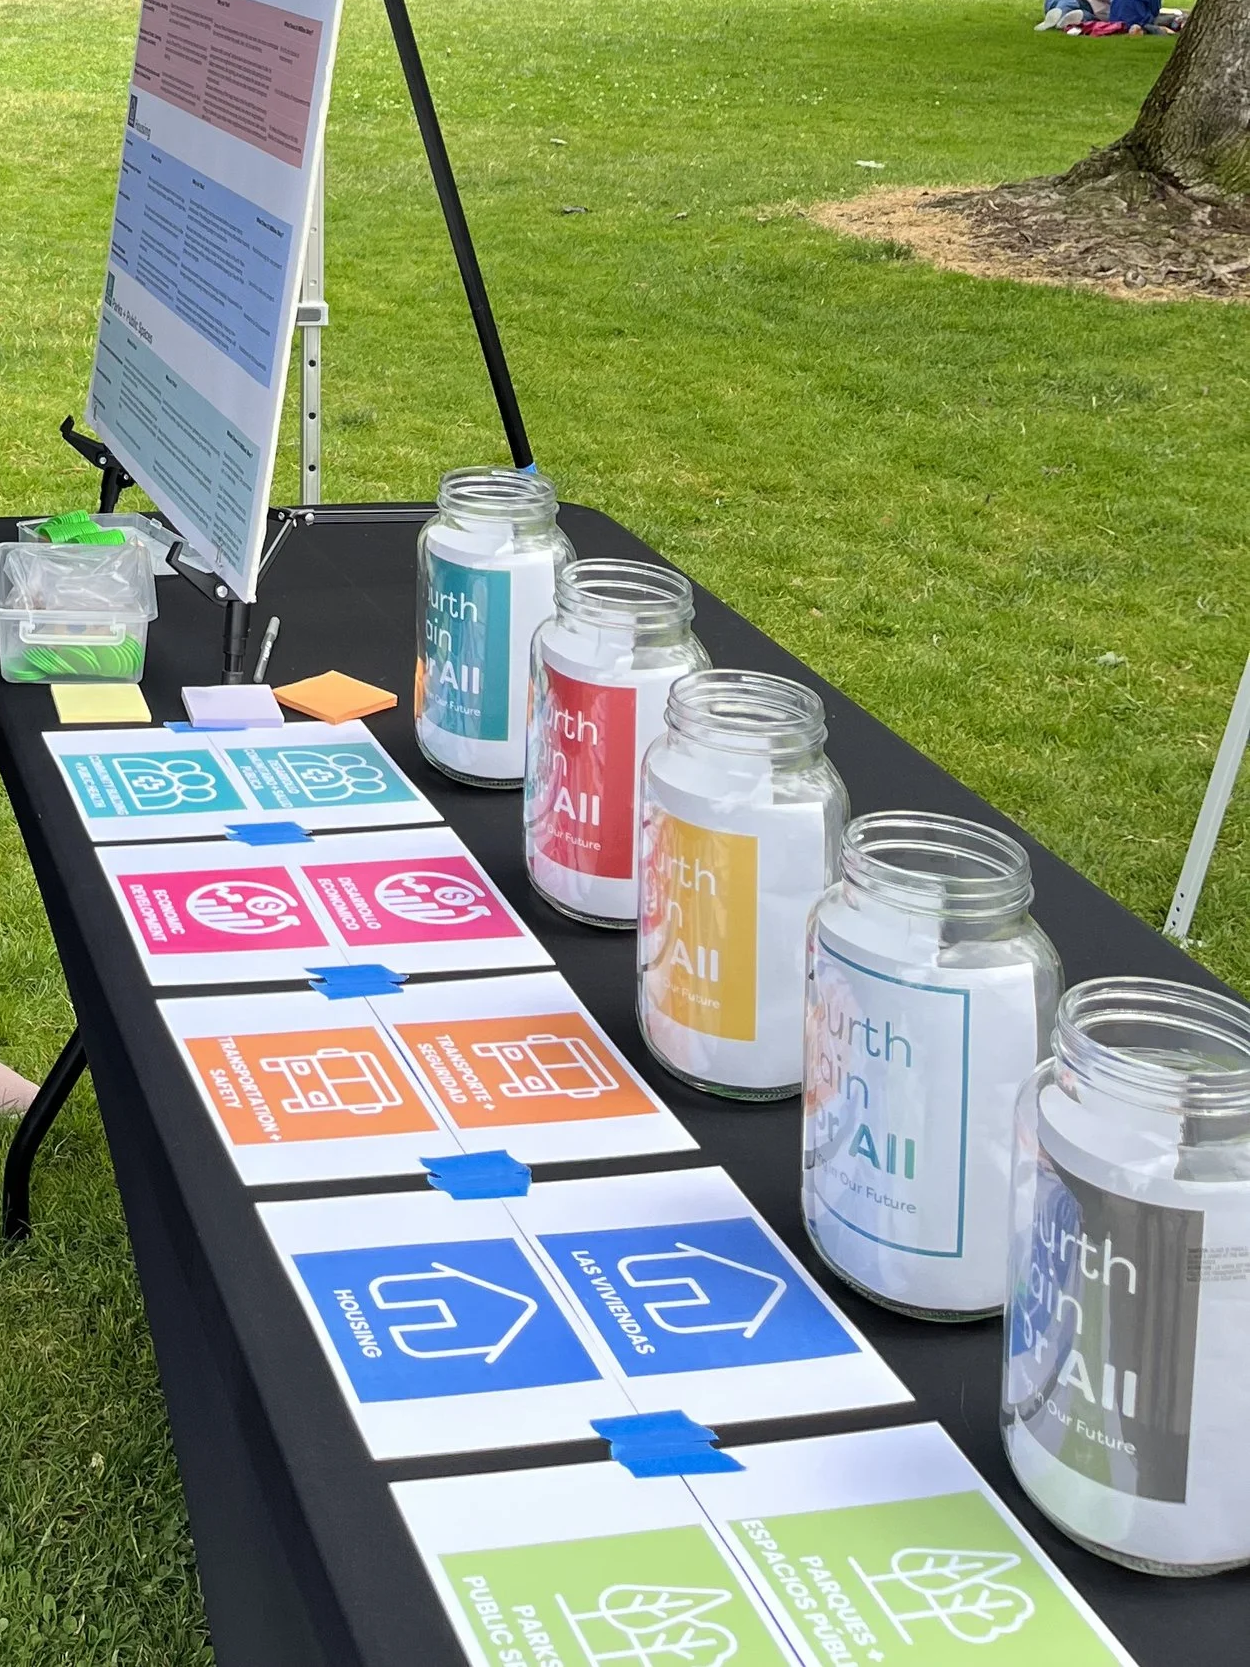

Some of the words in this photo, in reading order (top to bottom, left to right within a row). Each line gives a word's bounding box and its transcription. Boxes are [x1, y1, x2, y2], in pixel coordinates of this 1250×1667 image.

[439, 660, 480, 695] All
[449, 700, 481, 717] Future
[553, 785, 600, 826] All
[565, 831, 602, 851] Future
[128, 884, 168, 943] DEVELOPMENT
[152, 889, 186, 935] ECONOMIC
[337, 876, 382, 930] DESARROLLO
[669, 937, 719, 982] All
[681, 987, 721, 1009] Future
[209, 1068, 244, 1109] SAFETY
[217, 1036, 281, 1133] TRANSPORTATION
[416, 1042, 468, 1104] SEGURIDAD
[435, 1034, 493, 1103] TRANSPORTE
[848, 1123, 915, 1180] All
[839, 1171, 863, 1194] Our
[866, 1187, 917, 1214] Future
[1037, 1221, 1137, 1295] urth
[333, 1289, 383, 1359] HOUSING
[570, 1250, 603, 1276] LAS
[590, 1276, 656, 1355] VIVIENDAS
[1057, 1349, 1137, 1418] All
[1047, 1399, 1072, 1427] Our
[1076, 1420, 1137, 1456] Future
[741, 1519, 818, 1611] ESPACIOS
[462, 1575, 514, 1645] PUBLIC
[511, 1604, 564, 1667] PARKS
[799, 1555, 877, 1647] PARQUES
[867, 1648, 885, 1663] +
